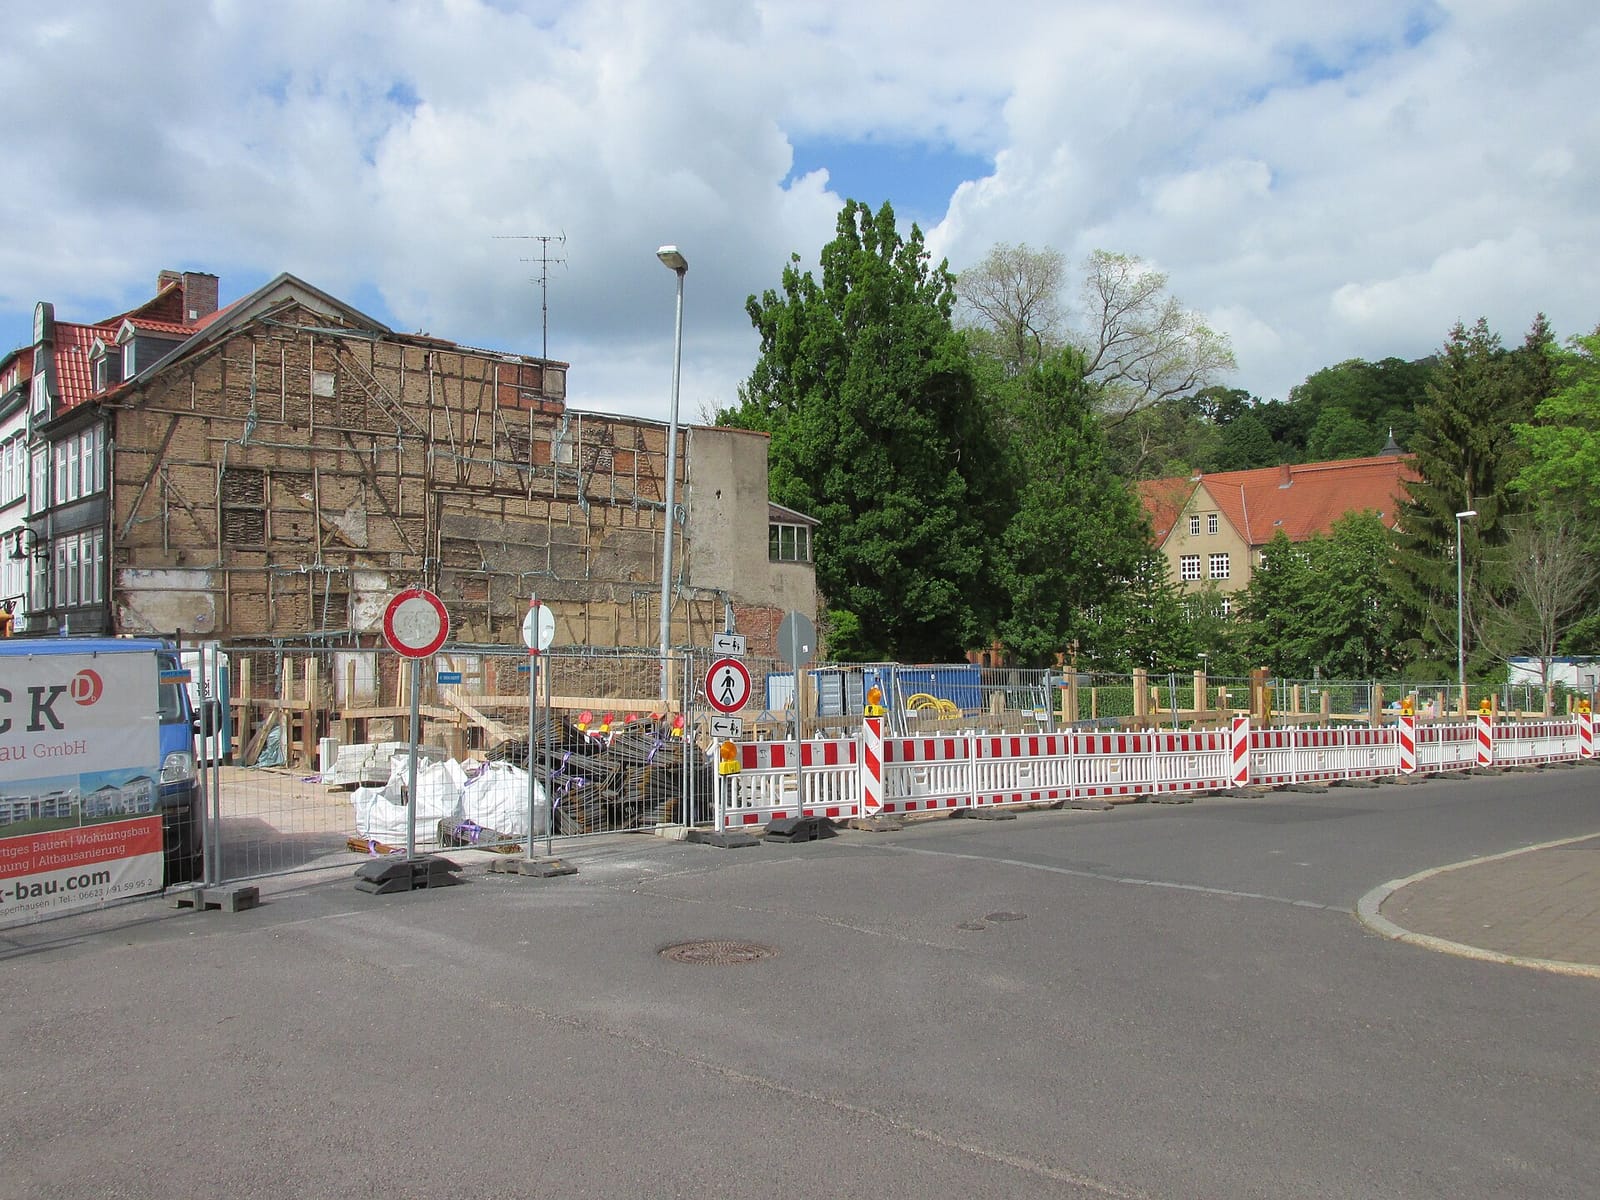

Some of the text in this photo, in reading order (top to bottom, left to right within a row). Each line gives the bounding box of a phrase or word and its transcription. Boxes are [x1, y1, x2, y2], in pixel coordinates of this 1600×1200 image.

[33, 740, 87, 758] GmbH
[33, 839, 68, 853] Bauen
[76, 826, 150, 845] Wohnungsbau
[39, 845, 125, 866] Altbausanierung
